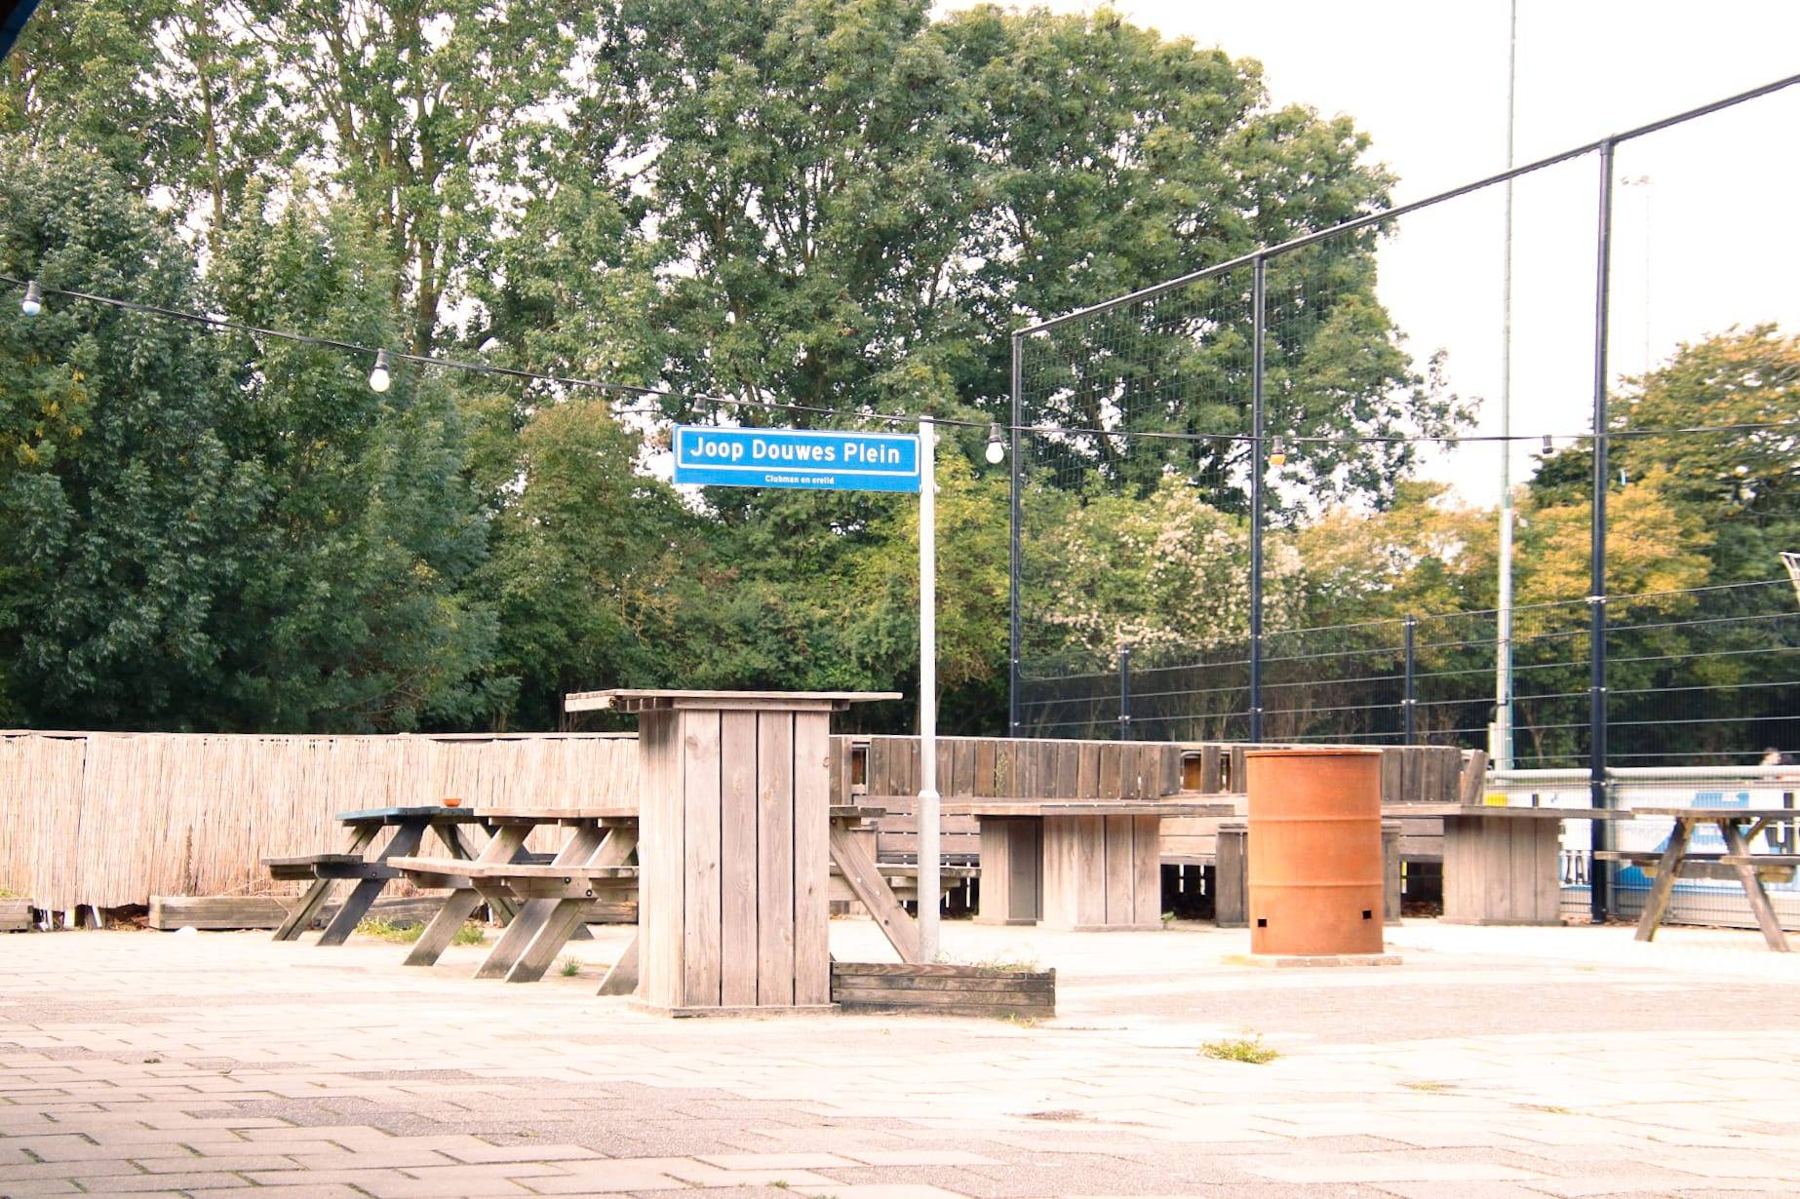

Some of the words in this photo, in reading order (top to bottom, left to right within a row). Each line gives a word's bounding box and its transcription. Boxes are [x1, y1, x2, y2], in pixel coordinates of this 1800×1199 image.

[690, 436, 744, 462] Joop
[752, 439, 836, 462] Douwes
[844, 442, 901, 464] Plein
[765, 474, 800, 483] Clubman
[812, 476, 835, 485] erelid
